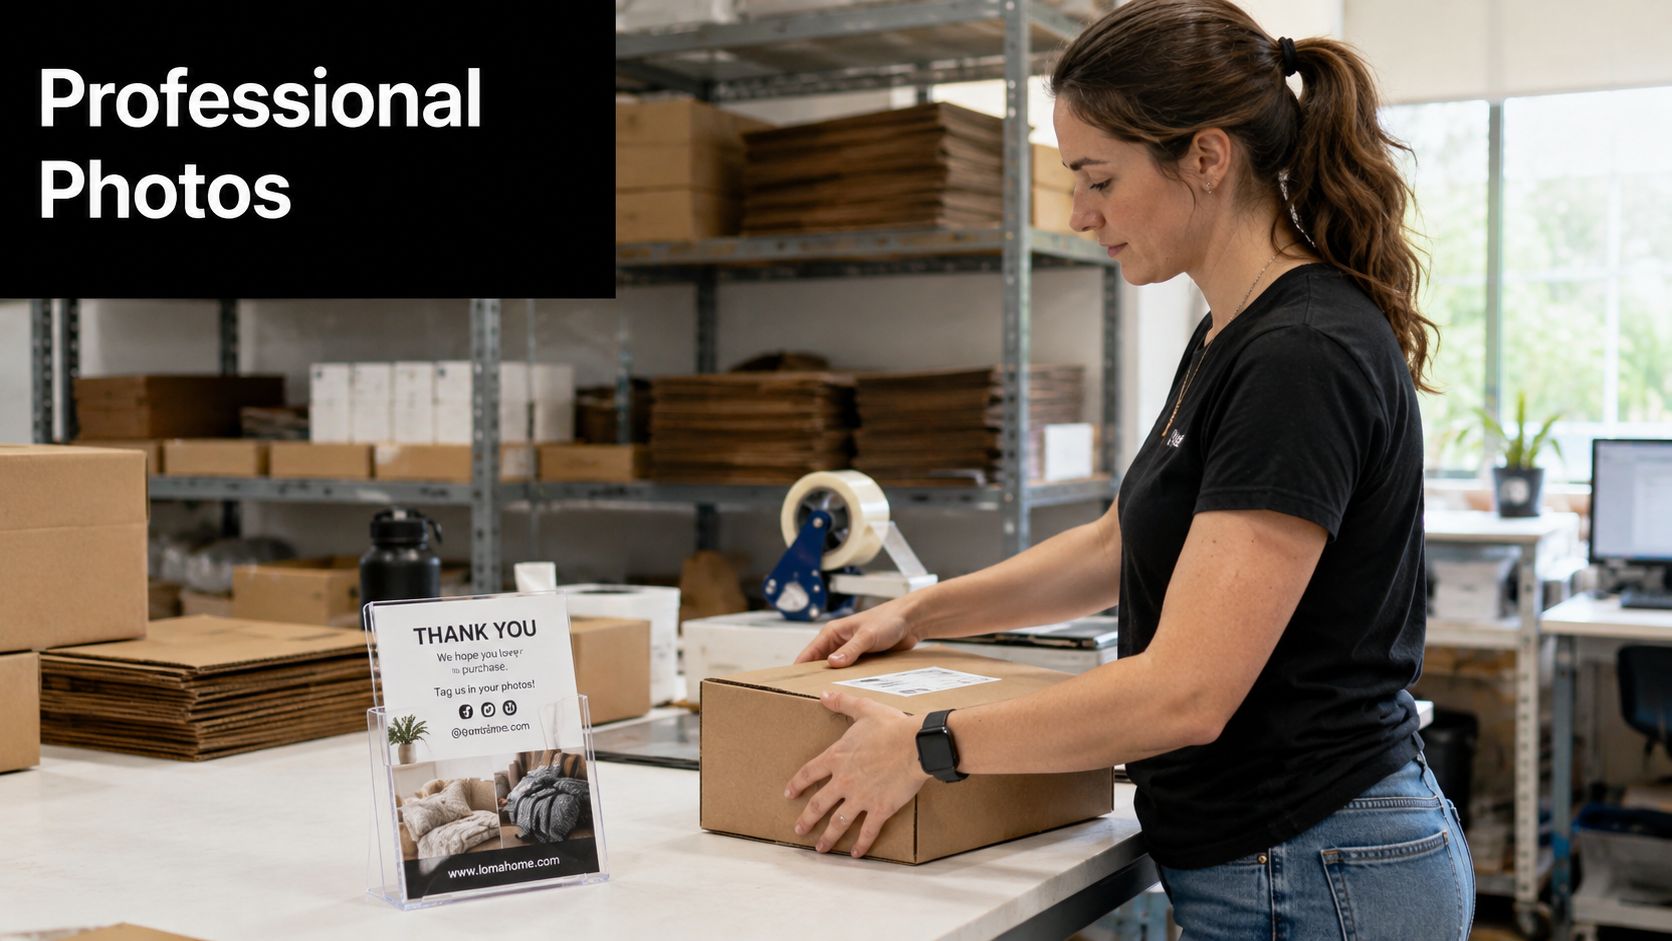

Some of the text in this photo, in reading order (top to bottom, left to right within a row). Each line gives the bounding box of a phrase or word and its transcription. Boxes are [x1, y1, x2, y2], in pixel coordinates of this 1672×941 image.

[413, 619, 537, 646] THANK YOU
[437, 652, 453, 662] We
[454, 651, 479, 663] hope
[480, 650, 498, 662] you
[462, 663, 509, 676] purchase.
[434, 680, 536, 699] Tag us in your photos!
[447, 856, 560, 879] www.lomahome.com
